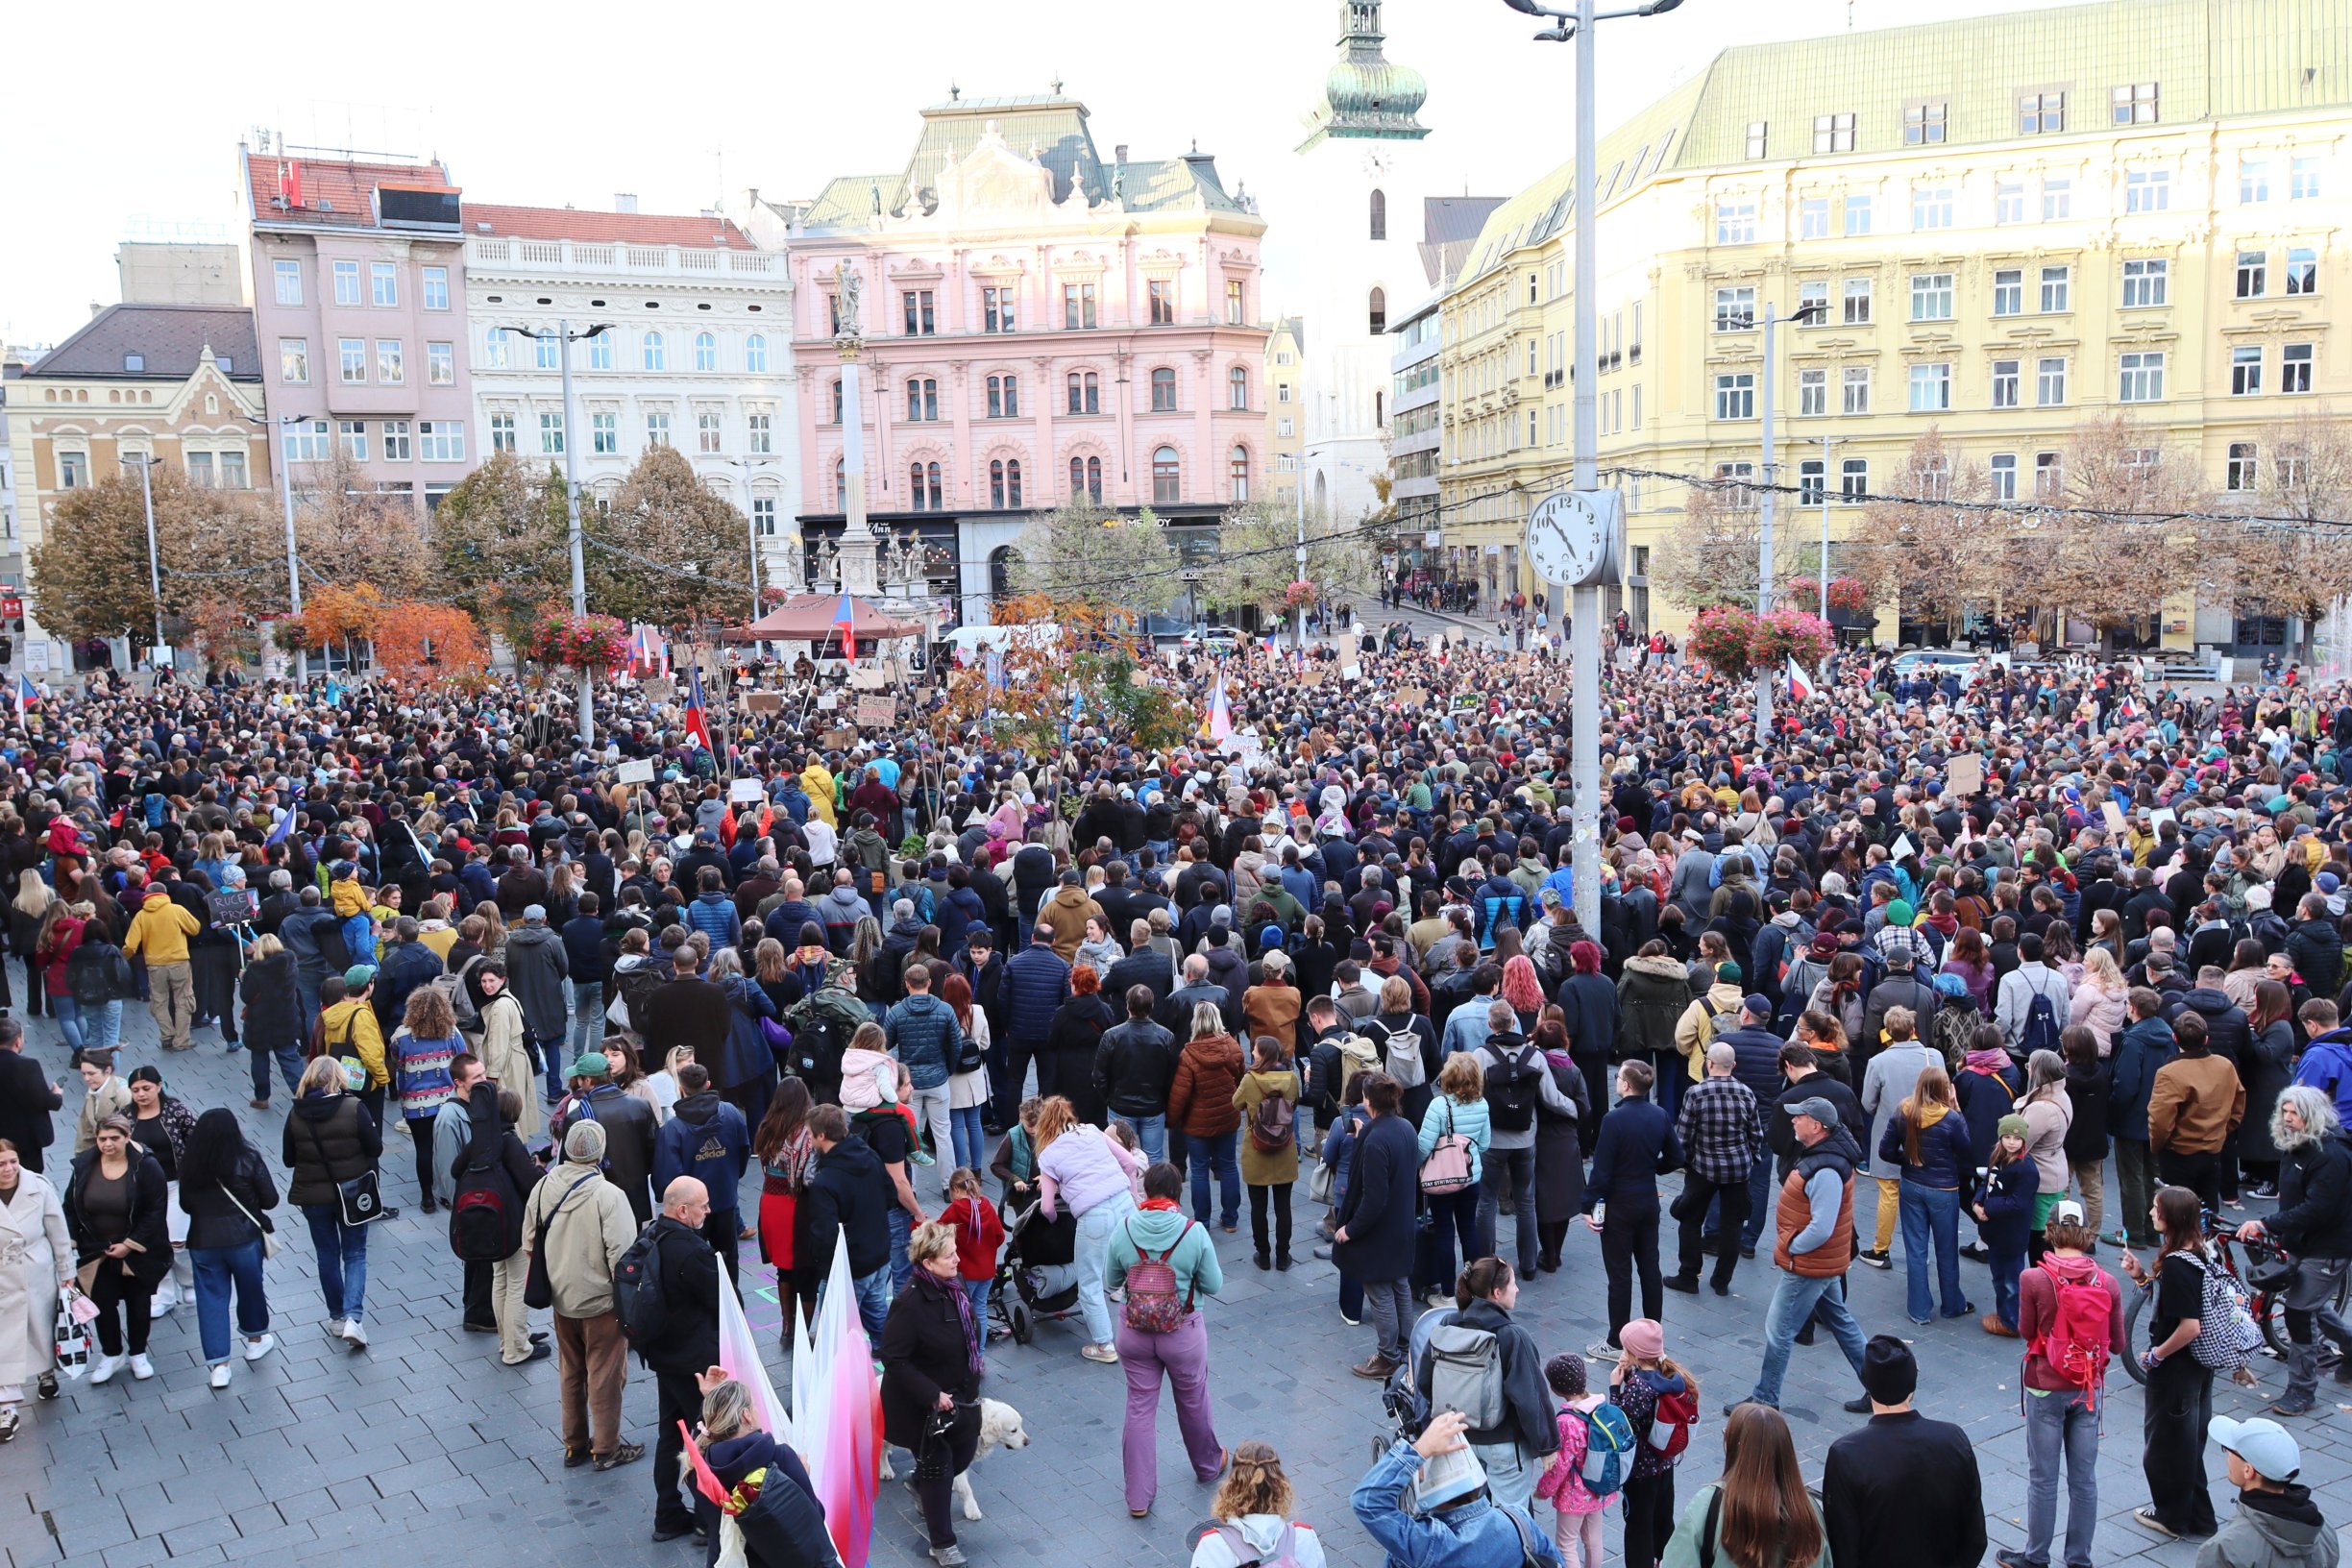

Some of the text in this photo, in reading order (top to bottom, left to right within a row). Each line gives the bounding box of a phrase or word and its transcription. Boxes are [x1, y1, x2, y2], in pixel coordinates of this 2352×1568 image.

[1546, 502, 1556, 514] 11
[1559, 496, 1572, 508] 12
[1577, 501, 1582, 512] 1
[1127, 518, 1171, 527] MEDY
[1536, 517, 1549, 528] 10
[1586, 513, 1595, 525] 2
[1531, 534, 1539, 546] 9
[1592, 532, 1600, 545] 3
[1536, 551, 1544, 563] 8
[1586, 551, 1593, 562] 4
[1547, 565, 1554, 576] 7
[1561, 569, 1569, 581] 6
[1577, 565, 1584, 576] 5
[213, 893, 246, 907] RUCE
[696, 1149, 726, 1161] adidas
